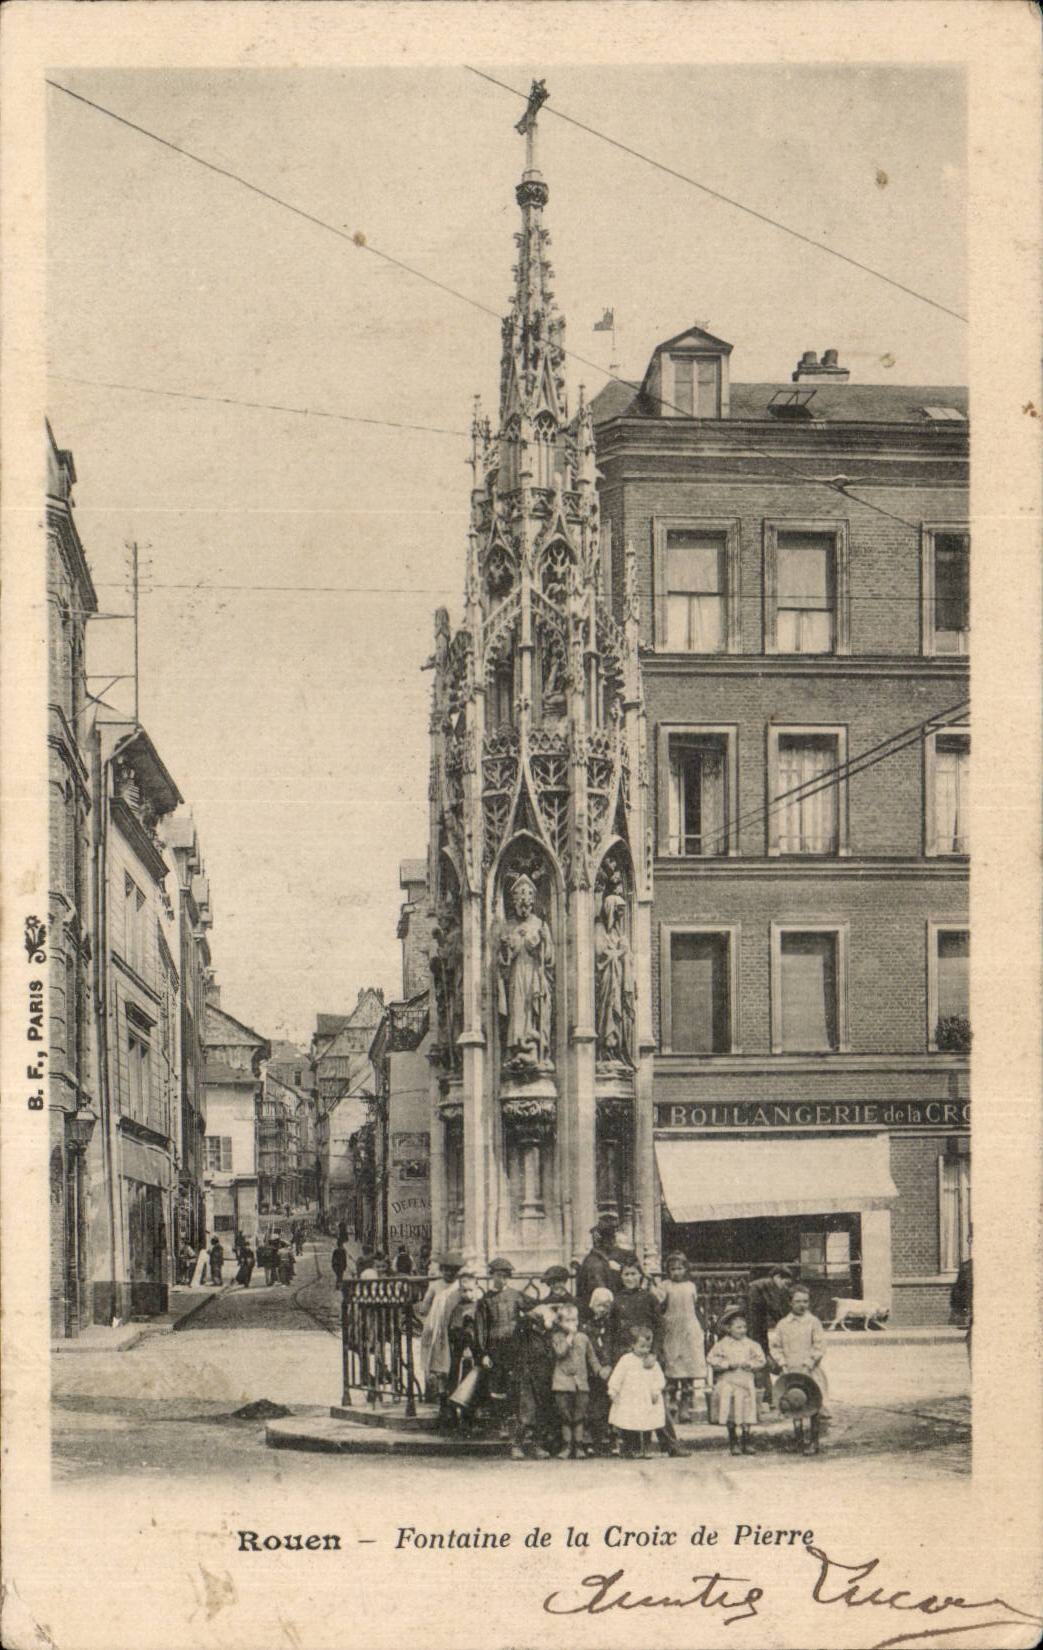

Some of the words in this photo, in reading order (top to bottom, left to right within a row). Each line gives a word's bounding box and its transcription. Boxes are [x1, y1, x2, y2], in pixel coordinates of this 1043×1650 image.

[670, 1104, 878, 1126] BOULANGERIE
[883, 1104, 904, 1123] de
[907, 1103, 921, 1123] la
